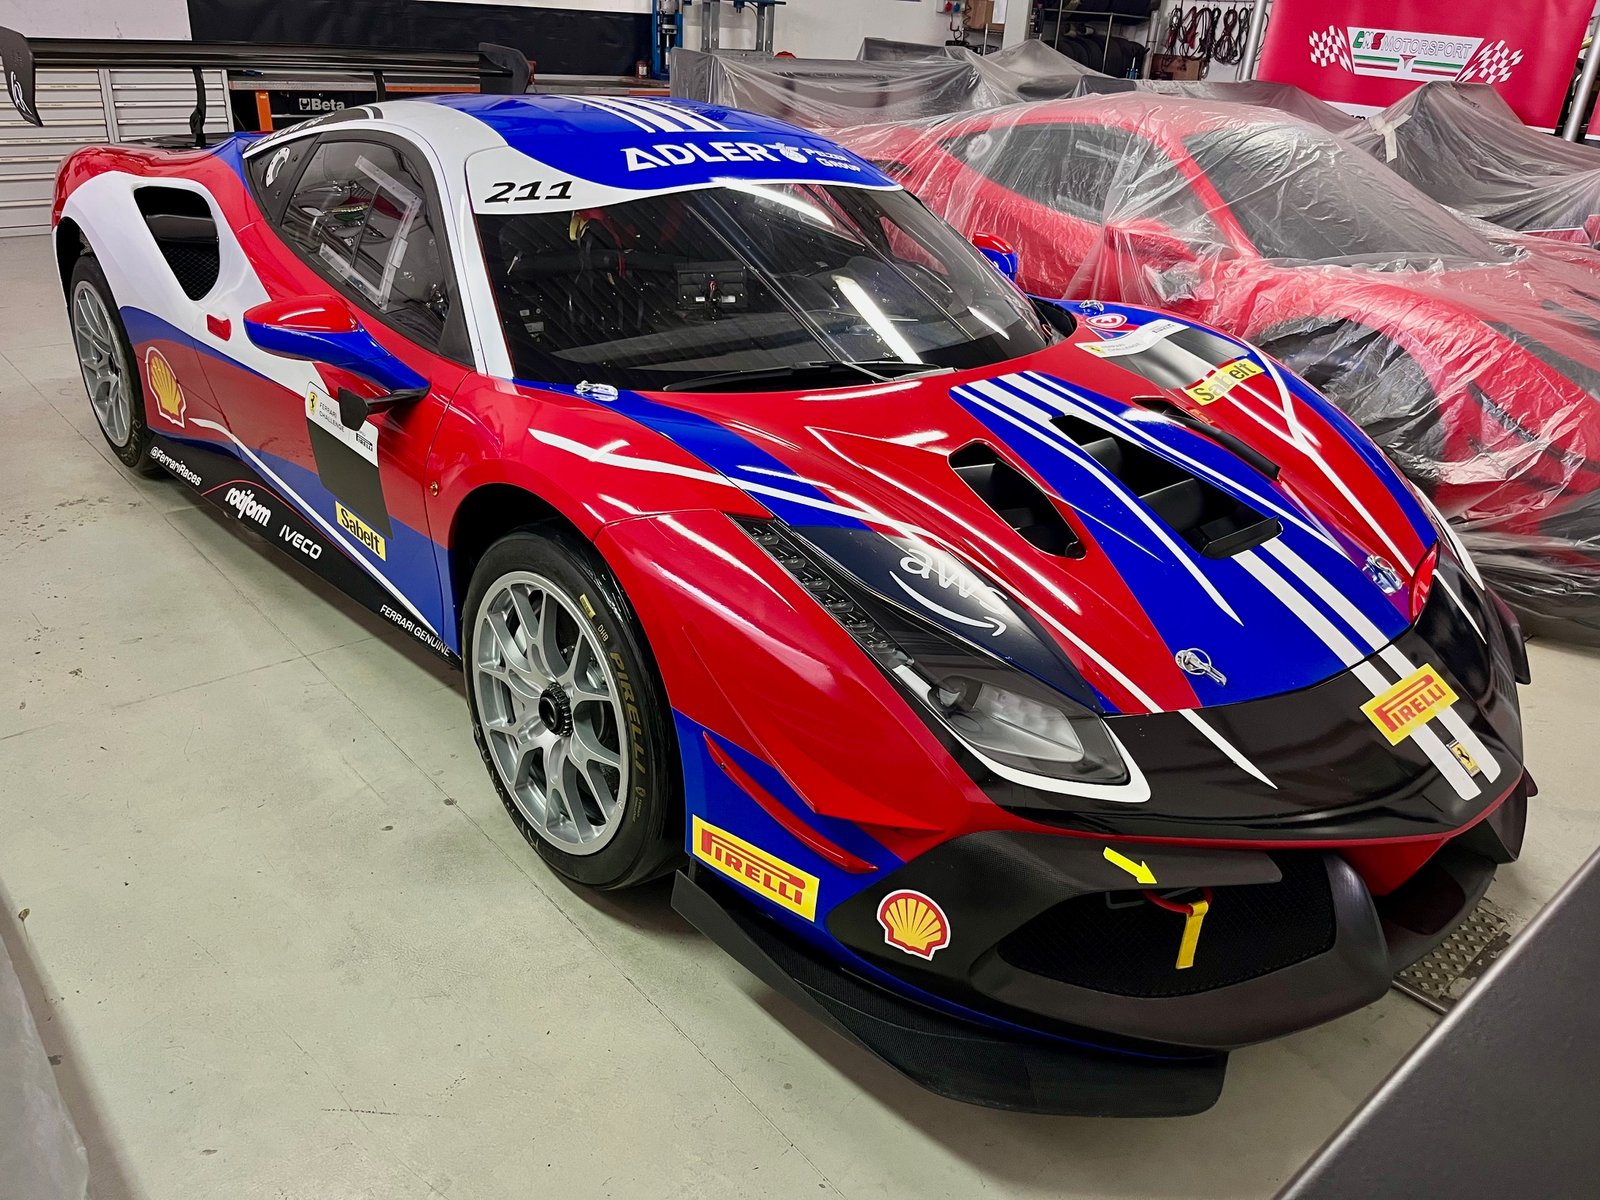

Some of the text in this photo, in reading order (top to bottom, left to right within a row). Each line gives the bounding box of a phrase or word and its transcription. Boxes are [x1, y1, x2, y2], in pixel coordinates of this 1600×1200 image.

[1352, 30, 1473, 59] CMS MOTORSPORT
[312, 98, 345, 111] Beta
[620, 141, 781, 172] ADLER
[484, 180, 573, 204] 211
[1193, 362, 1257, 403] Sabelt
[150, 446, 203, 487] @FerrariRaces
[224, 487, 272, 527] rotiform
[279, 524, 323, 560] IVECO
[340, 507, 381, 555] Sabelt
[380, 604, 451, 657] FERRARI GENUINE
[609, 650, 646, 776] PIRELLI
[1372, 673, 1447, 734] PIRELLI
[701, 827, 806, 906] PIRELLI
